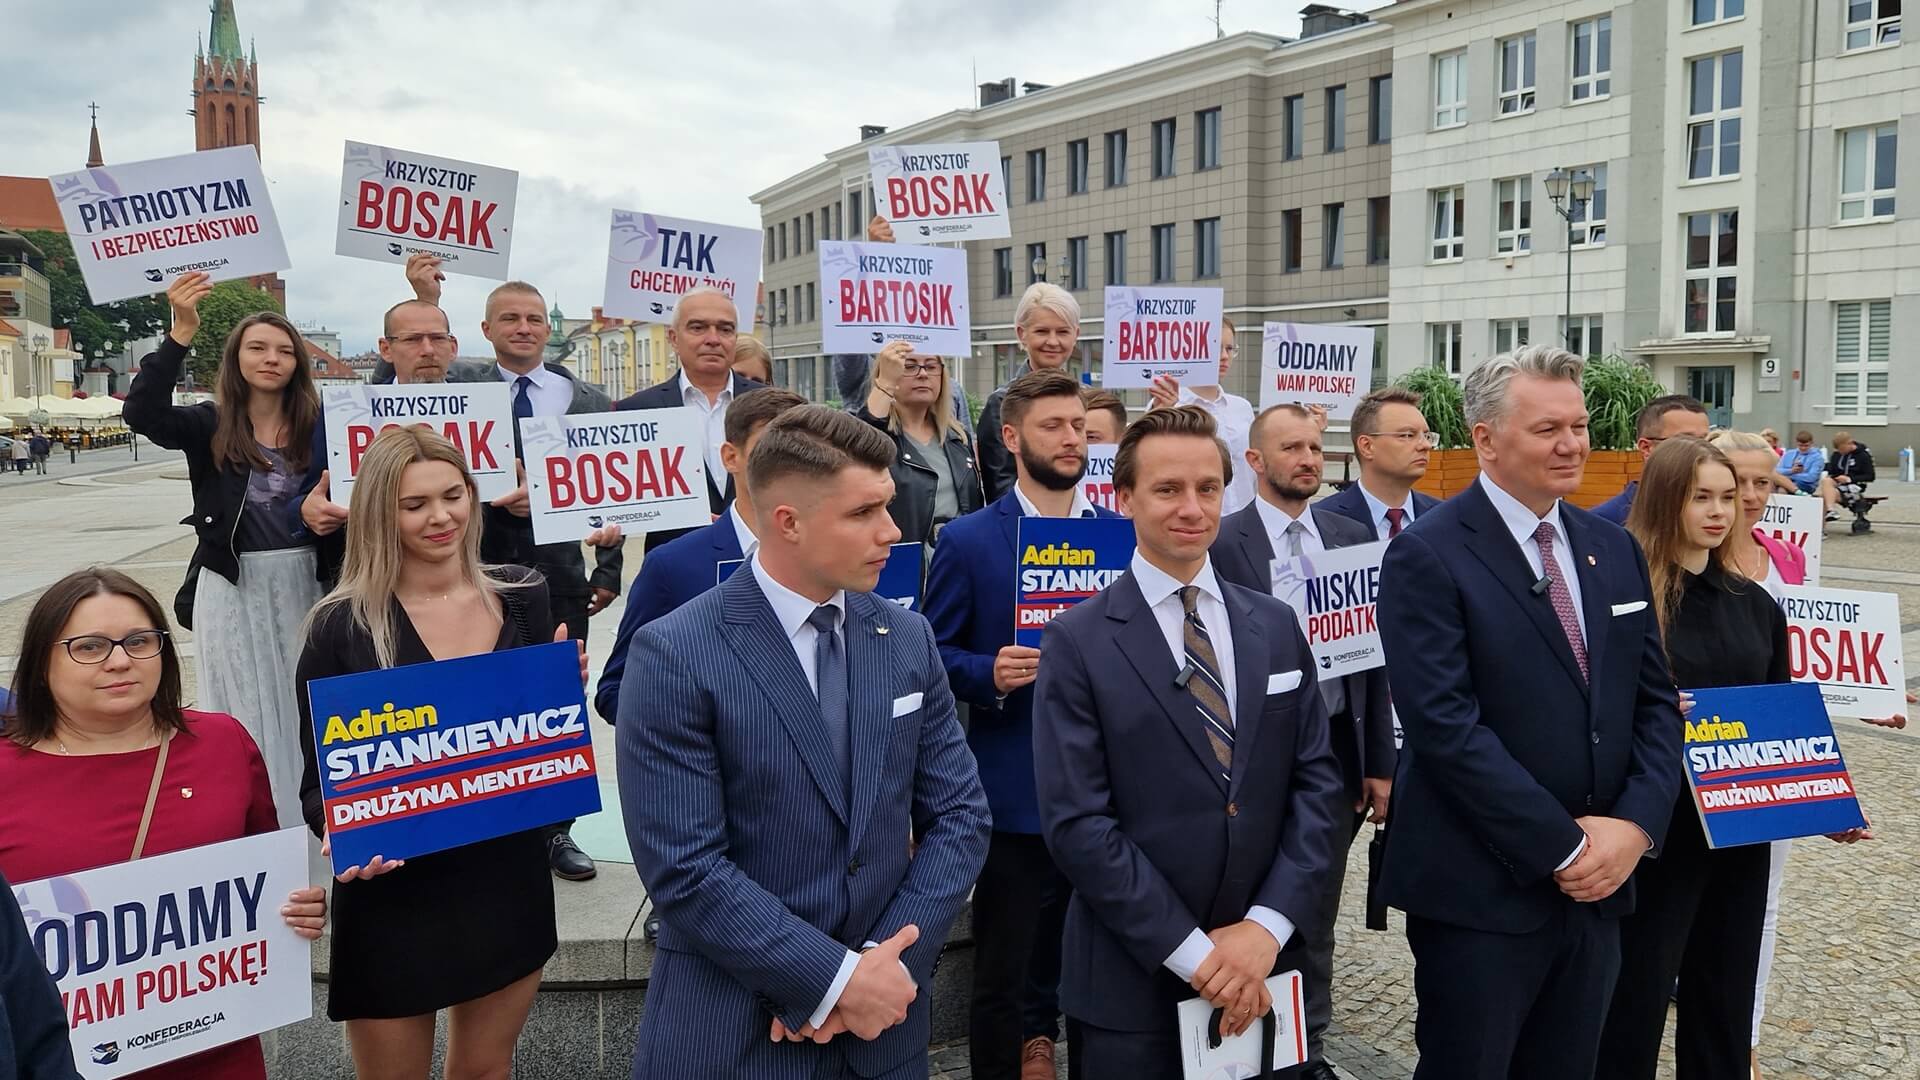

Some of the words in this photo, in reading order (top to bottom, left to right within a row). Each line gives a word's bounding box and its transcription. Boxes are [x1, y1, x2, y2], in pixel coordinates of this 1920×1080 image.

[385, 160, 477, 192] KRZYSZTOF
[902, 153, 970, 172] KRZYSZTOF
[78, 178, 252, 233] PATRIOTYZM
[357, 180, 498, 249] BOSAK
[887, 173, 995, 219] BOSAK
[92, 241, 101, 261] I
[102, 214, 260, 260] BEZPIECZEŃSTWO
[658, 228, 719, 273] TAK
[165, 258, 229, 275] KONFEDERACJA
[859, 255, 933, 276] KRZYSZTOF
[840, 279, 955, 326] BARTOSIK
[1136, 299, 1197, 315] KRZYSZTOF
[1119, 321, 1210, 360] BARTOSIK
[1278, 341, 1358, 372] ODDAMY
[1766, 360, 1775, 373] 9
[1277, 374, 1305, 392] WAM
[1308, 375, 1356, 397] POLSKĘ!
[371, 396, 468, 417] KRZYSZTOF
[566, 422, 658, 448] KRZYSZTOF
[545, 446, 691, 509] BOSAK
[606, 510, 661, 523] KONFEDERACJA
[1760, 505, 1792, 524] ZTOF
[1021, 543, 1095, 566] Adrian
[1306, 566, 1380, 615] NISKIE
[1308, 604, 1377, 645] PODATK
[1333, 647, 1375, 662] KONFEDERACJA
[322, 702, 438, 745] Adrian
[1684, 716, 1748, 744] Adrian
[326, 704, 584, 782] STANKIEWICZ
[1689, 735, 1839, 772] STANKIEWICZ
[332, 787, 458, 826] DRUŻYNA
[462, 754, 590, 797] MENTZENA
[1701, 783, 1774, 808] DRUŻYNA
[1773, 777, 1851, 800] MENTZENA
[34, 871, 267, 983] ODDAMY
[136, 940, 268, 1011] POLSKĘ!
[127, 1011, 225, 1049] KONFEDERACJA
